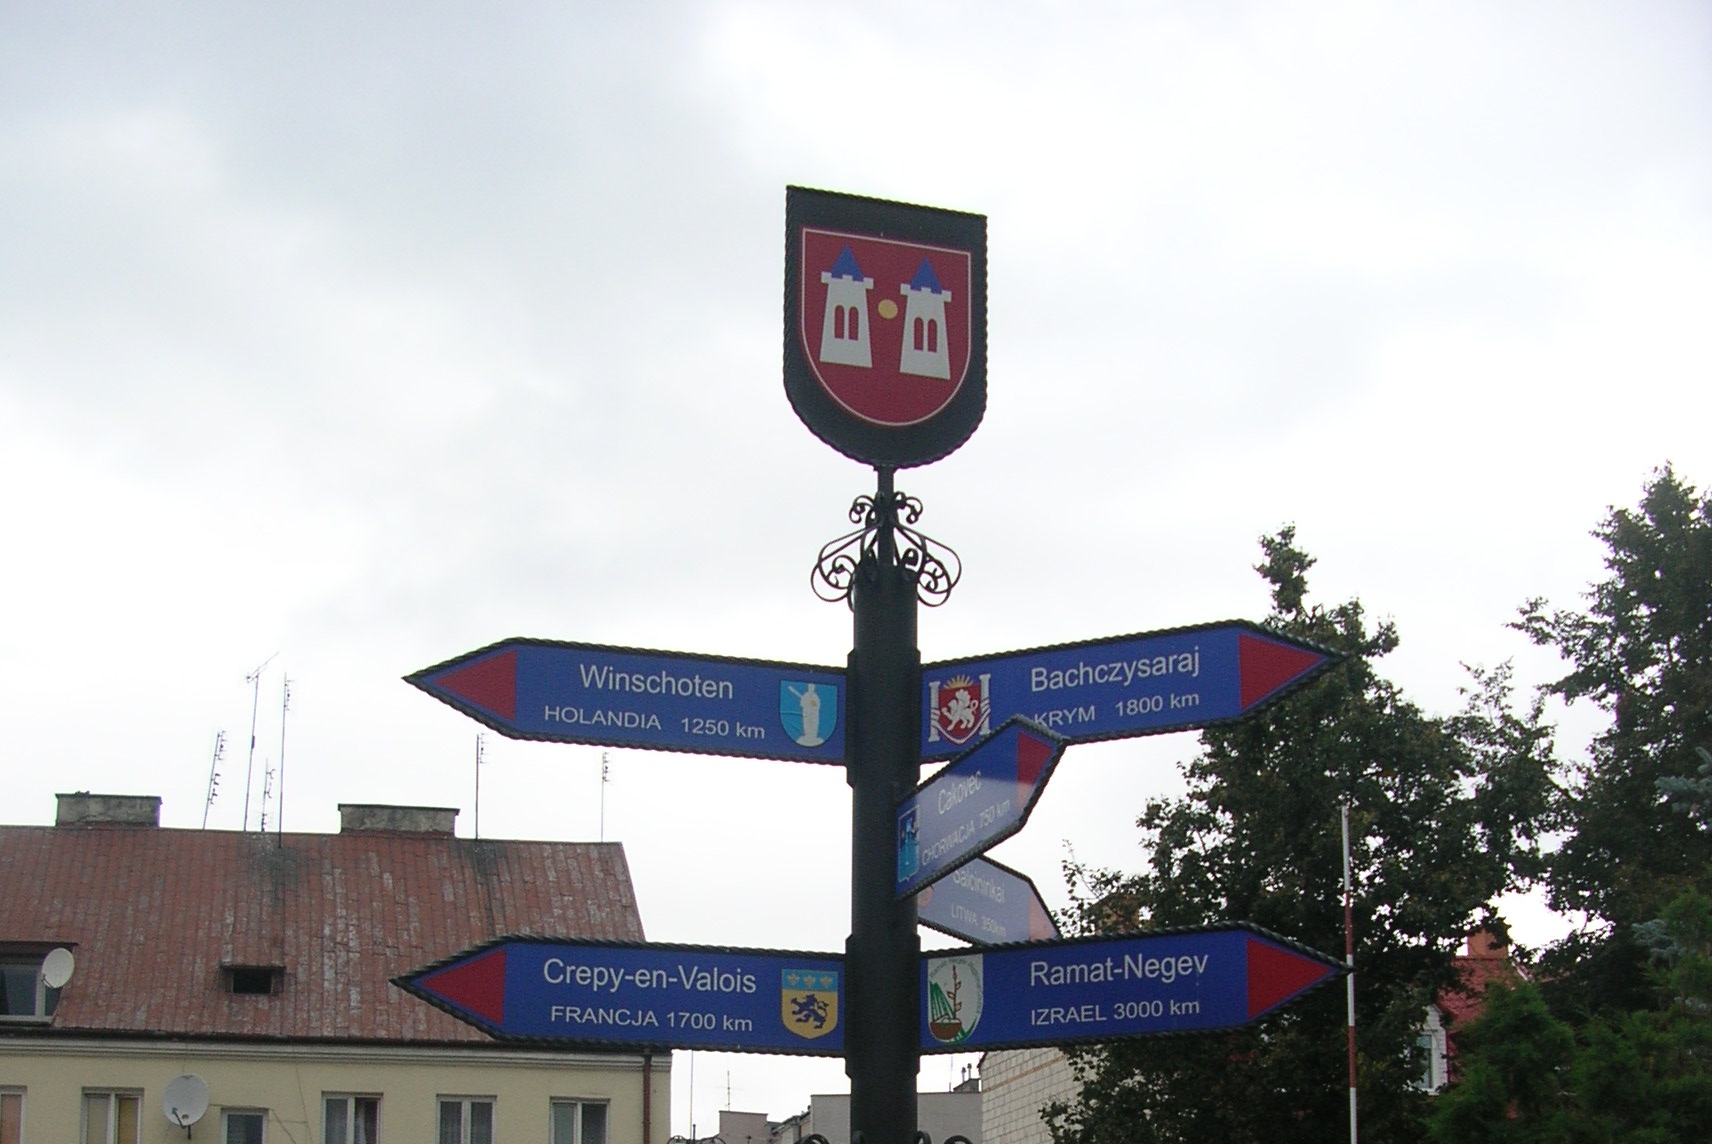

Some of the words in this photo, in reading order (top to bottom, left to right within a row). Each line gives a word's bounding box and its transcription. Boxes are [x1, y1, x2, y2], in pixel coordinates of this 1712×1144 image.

[579, 664, 733, 699] Winschoten
[1031, 645, 1200, 692] Bachczysaraj
[544, 705, 661, 731] HOLANDIA
[681, 717, 729, 737] 1250
[736, 721, 766, 740] km
[1034, 705, 1096, 728] KRYM
[1115, 695, 1164, 717] 1800
[1170, 692, 1199, 710] km
[543, 958, 757, 994] Crepy-en-Valois
[1030, 952, 1208, 988] Ramat-Negev
[551, 1006, 659, 1028] FRANCJA
[667, 1012, 716, 1031] 1700
[722, 1013, 753, 1032] km
[1031, 1005, 1107, 1027] IZRAEL
[1114, 1001, 1164, 1020] 3000
[1170, 999, 1199, 1016] km
